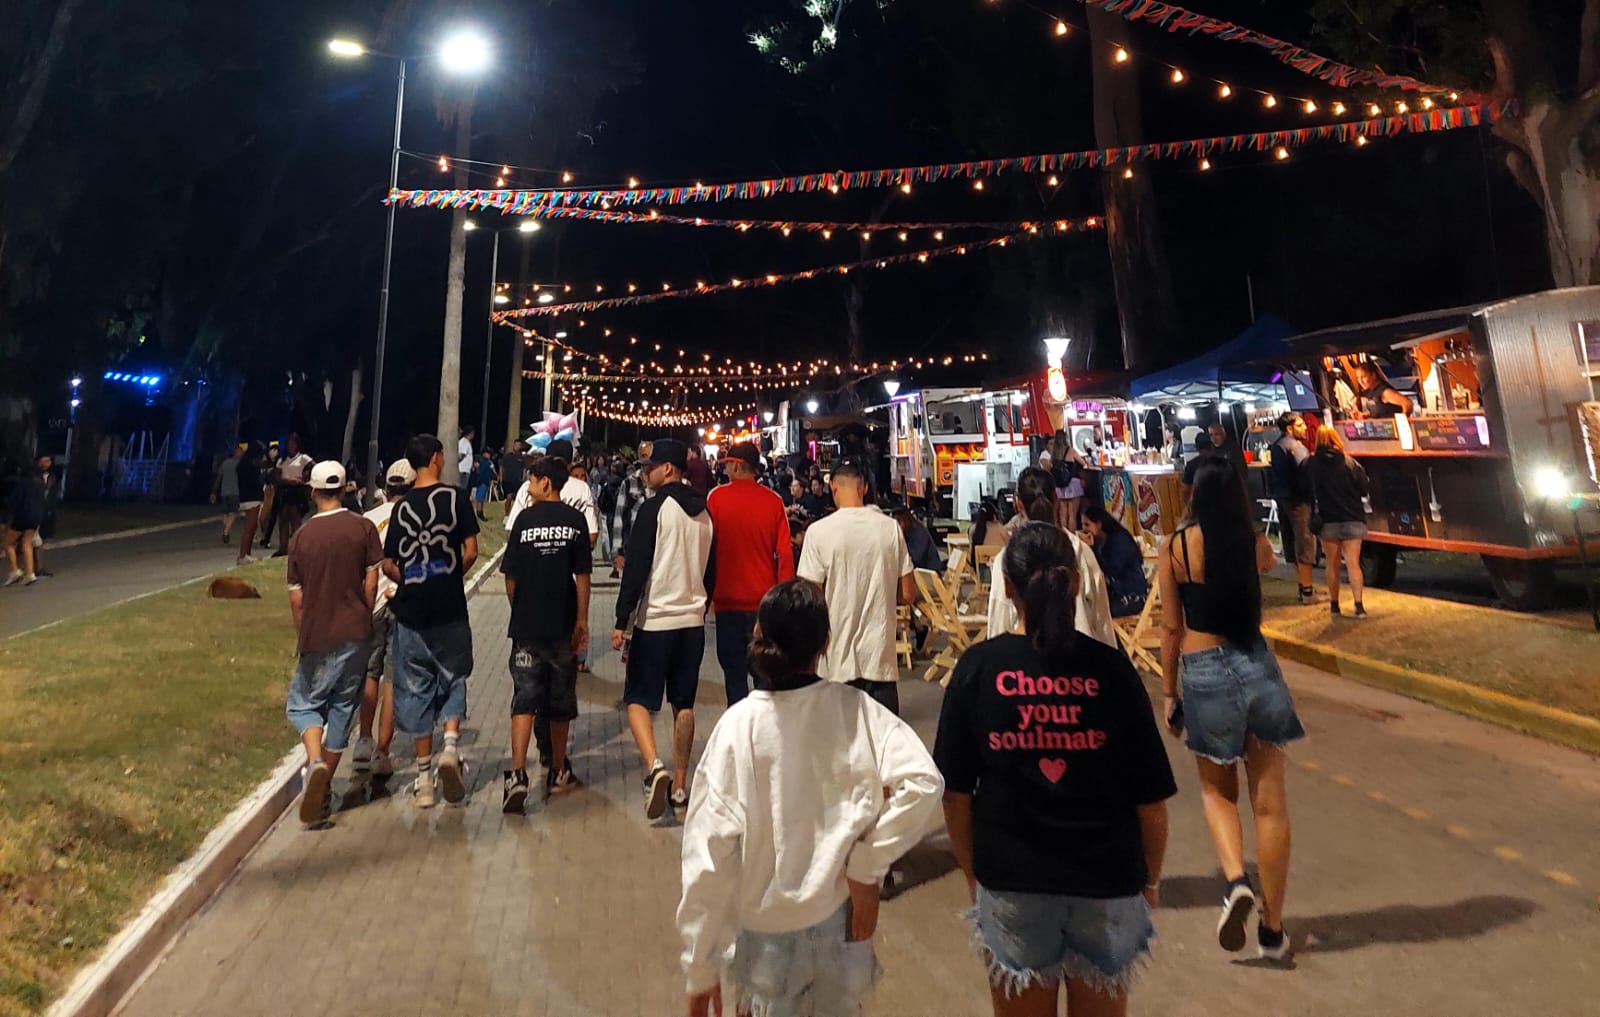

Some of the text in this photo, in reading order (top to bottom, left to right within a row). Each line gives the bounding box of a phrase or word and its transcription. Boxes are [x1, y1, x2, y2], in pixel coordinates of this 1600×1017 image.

[520, 526, 580, 543] REPRESENT
[995, 670, 1100, 696] Choose
[1017, 703, 1082, 730] your
[988, 725, 1107, 751] soulmate
